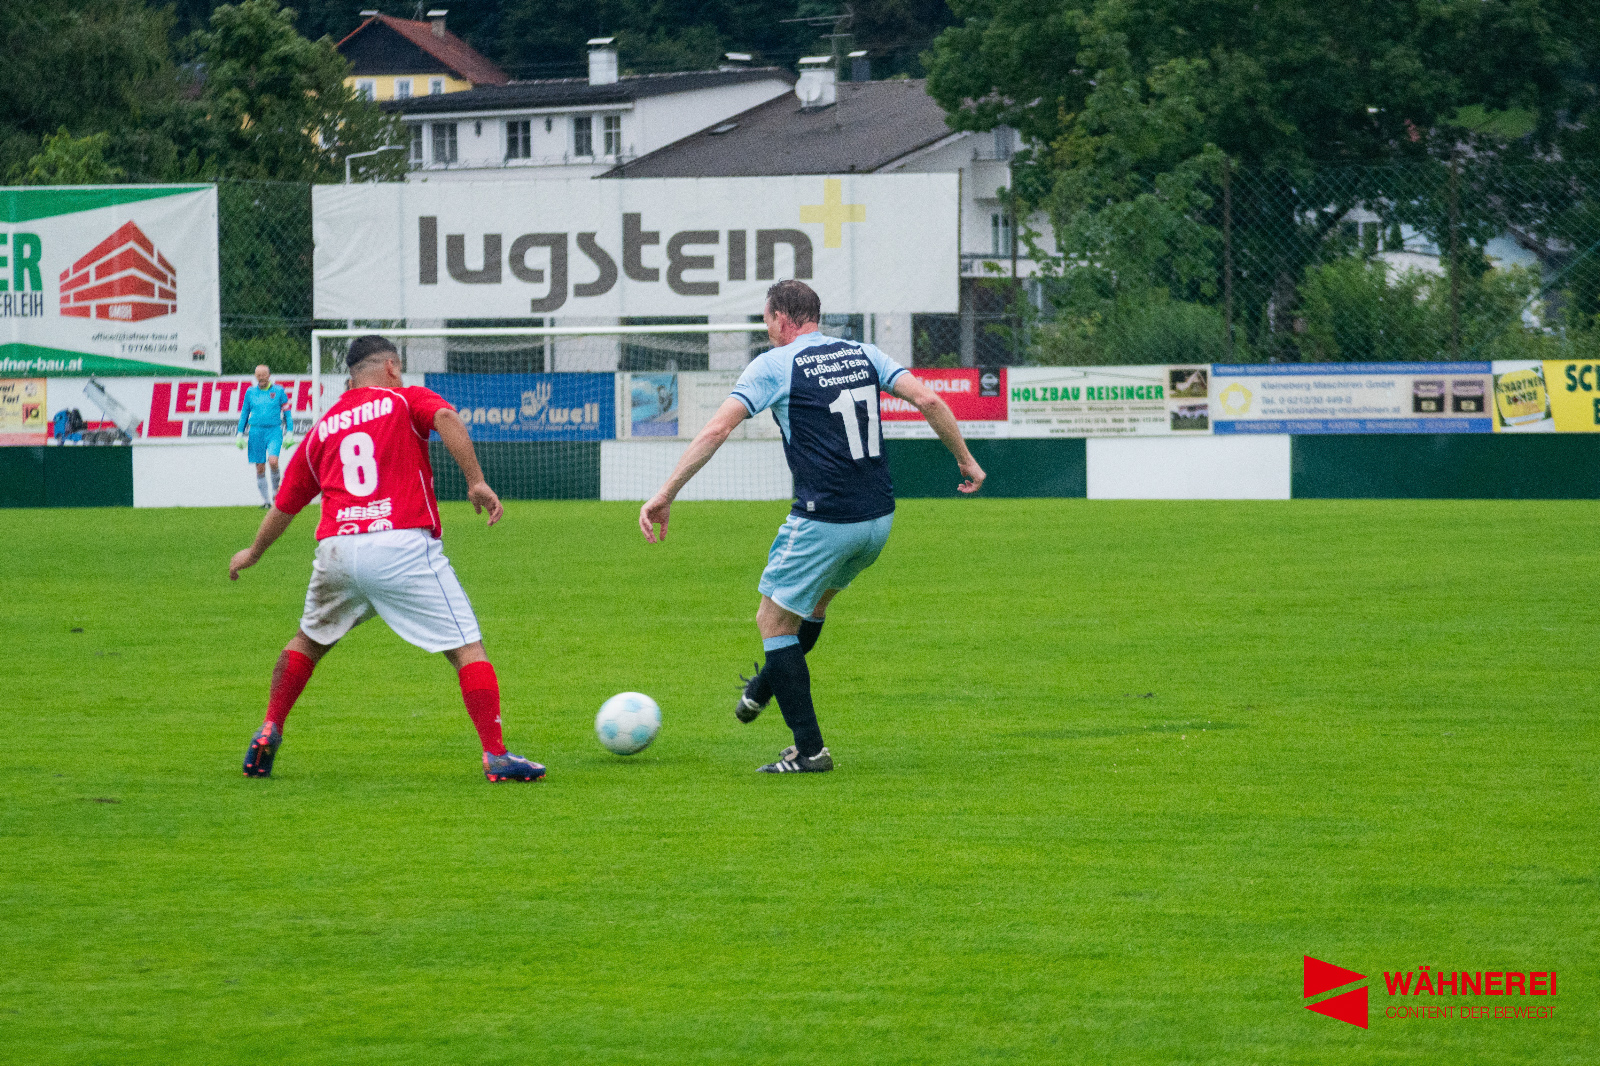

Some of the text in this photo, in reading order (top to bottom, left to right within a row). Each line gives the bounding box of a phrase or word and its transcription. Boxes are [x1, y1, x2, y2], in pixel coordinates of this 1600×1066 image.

[795, 347, 863, 367] Bürgermeister
[803, 358, 869, 378] Fußball-Team
[1564, 364, 1600, 392] SC
[818, 369, 869, 388] Österreich
[920, 378, 970, 392] NDLER
[1011, 387, 1080, 402] HOLZBAU
[1086, 385, 1164, 400] REISINGER
[318, 397, 393, 442] AUSTRIA
[456, 403, 600, 424] onau well
[829, 384, 881, 460] 17
[339, 431, 378, 497] 8
